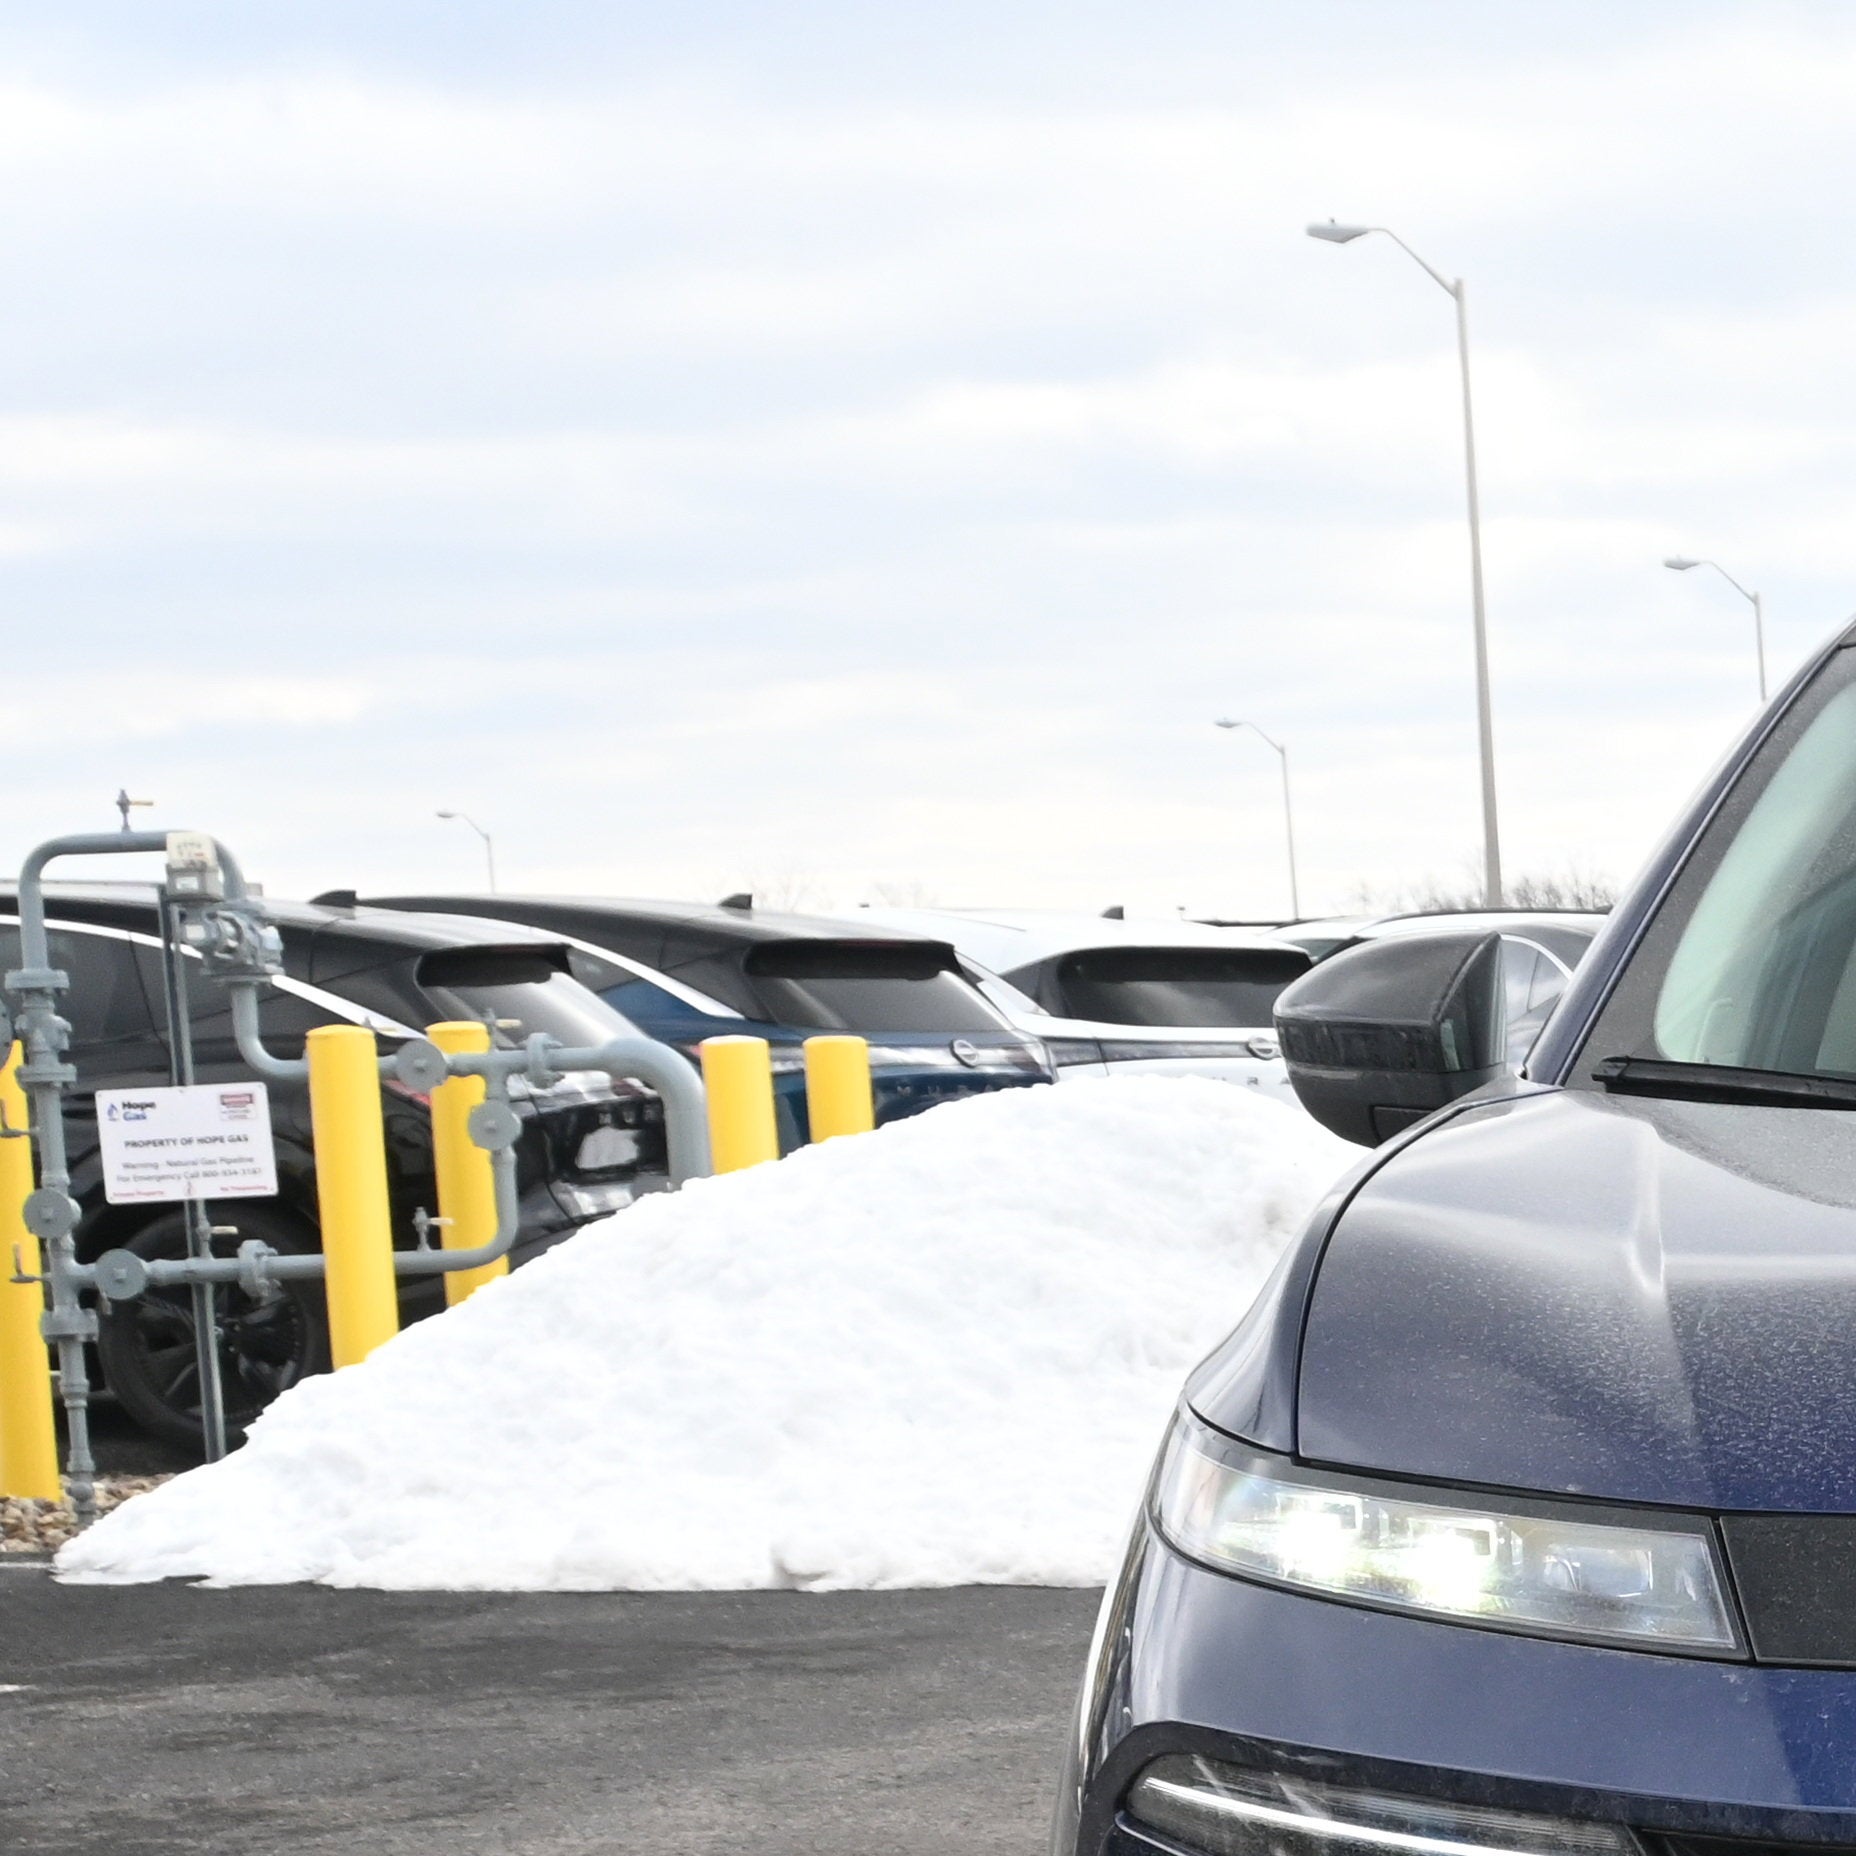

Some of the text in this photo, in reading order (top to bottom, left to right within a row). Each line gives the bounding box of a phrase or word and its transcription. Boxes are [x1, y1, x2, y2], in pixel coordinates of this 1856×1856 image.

[122, 1101, 156, 1111] Hope
[123, 1112, 147, 1121] Gas
[124, 1134, 249, 1148] PROPERTY OF HOPE GAS
